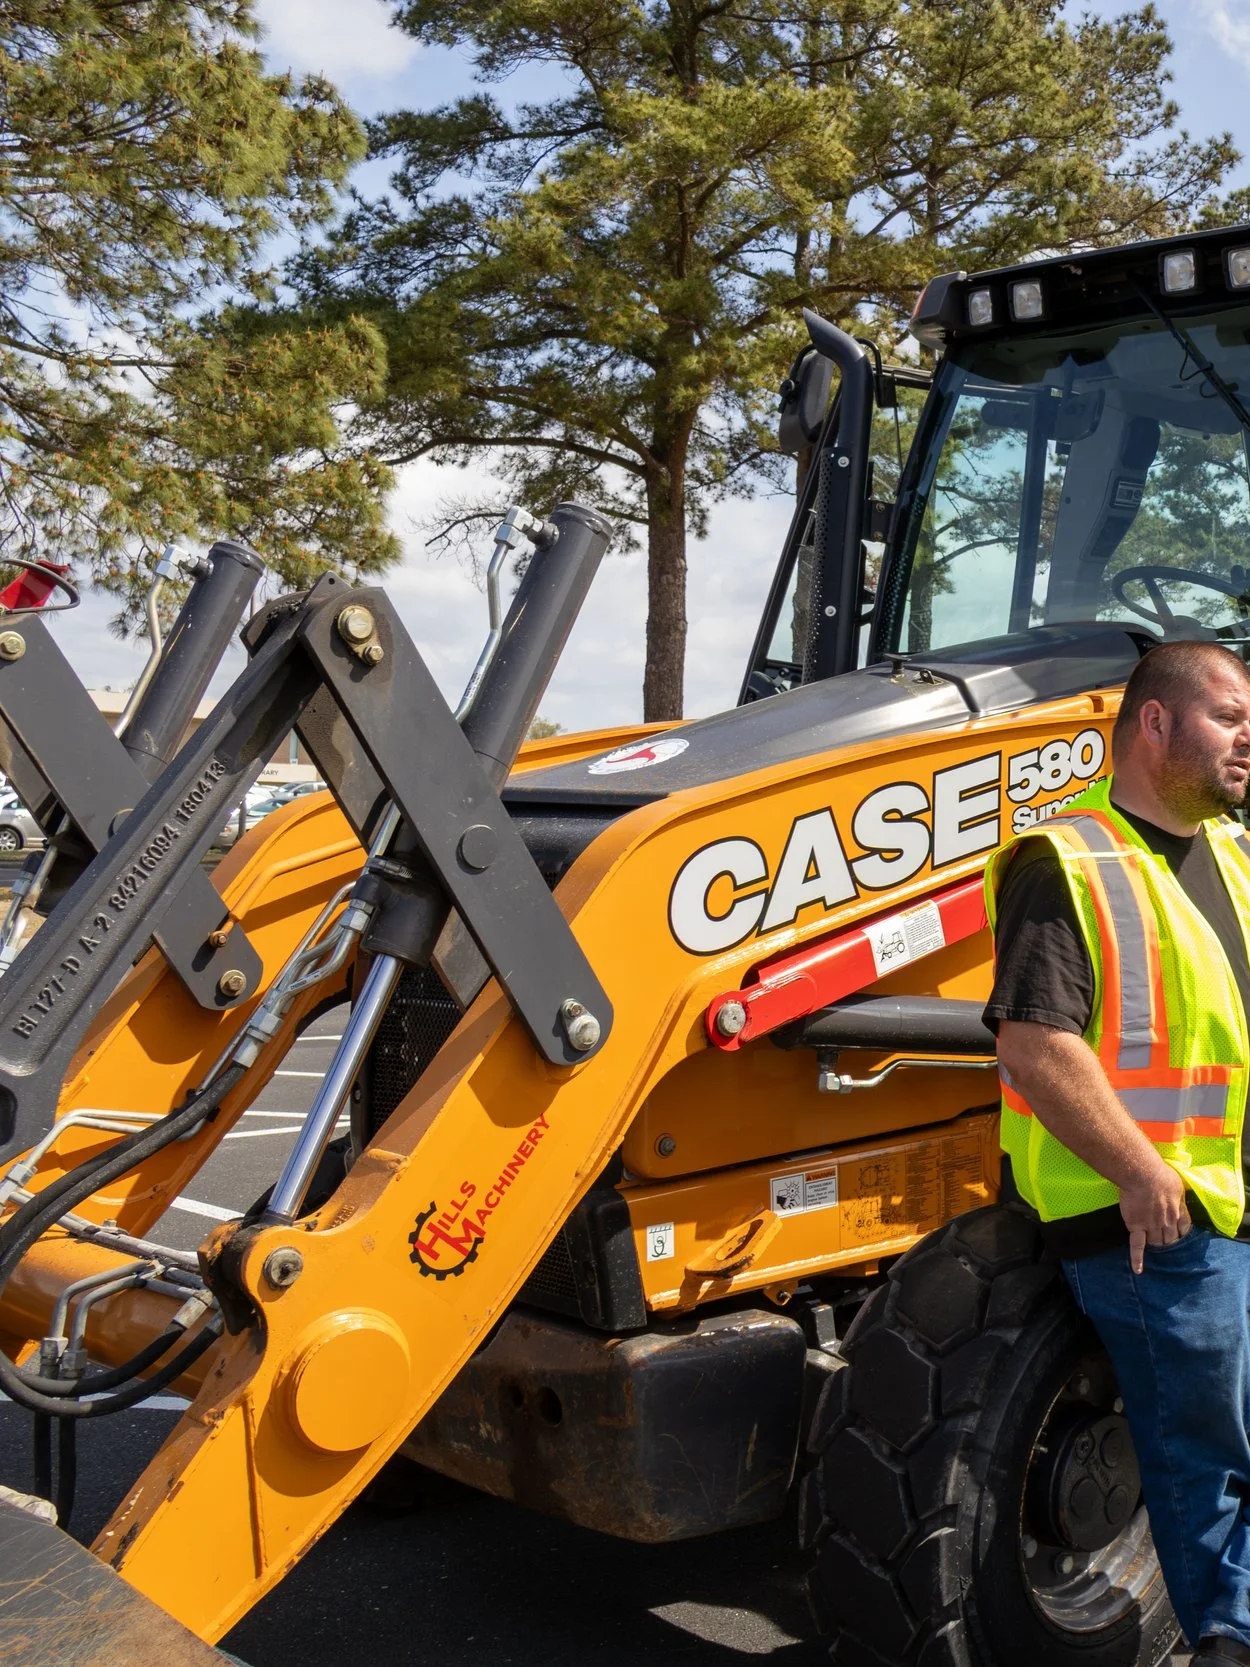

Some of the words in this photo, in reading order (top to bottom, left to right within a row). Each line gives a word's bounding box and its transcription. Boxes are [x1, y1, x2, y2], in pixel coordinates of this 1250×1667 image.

[1006, 727, 1106, 804] 580
[1012, 788, 1087, 835] Sup
[667, 750, 1002, 957] CASE
[414, 1181, 477, 1262] HILLS
[449, 1112, 550, 1258] MACHINERY
